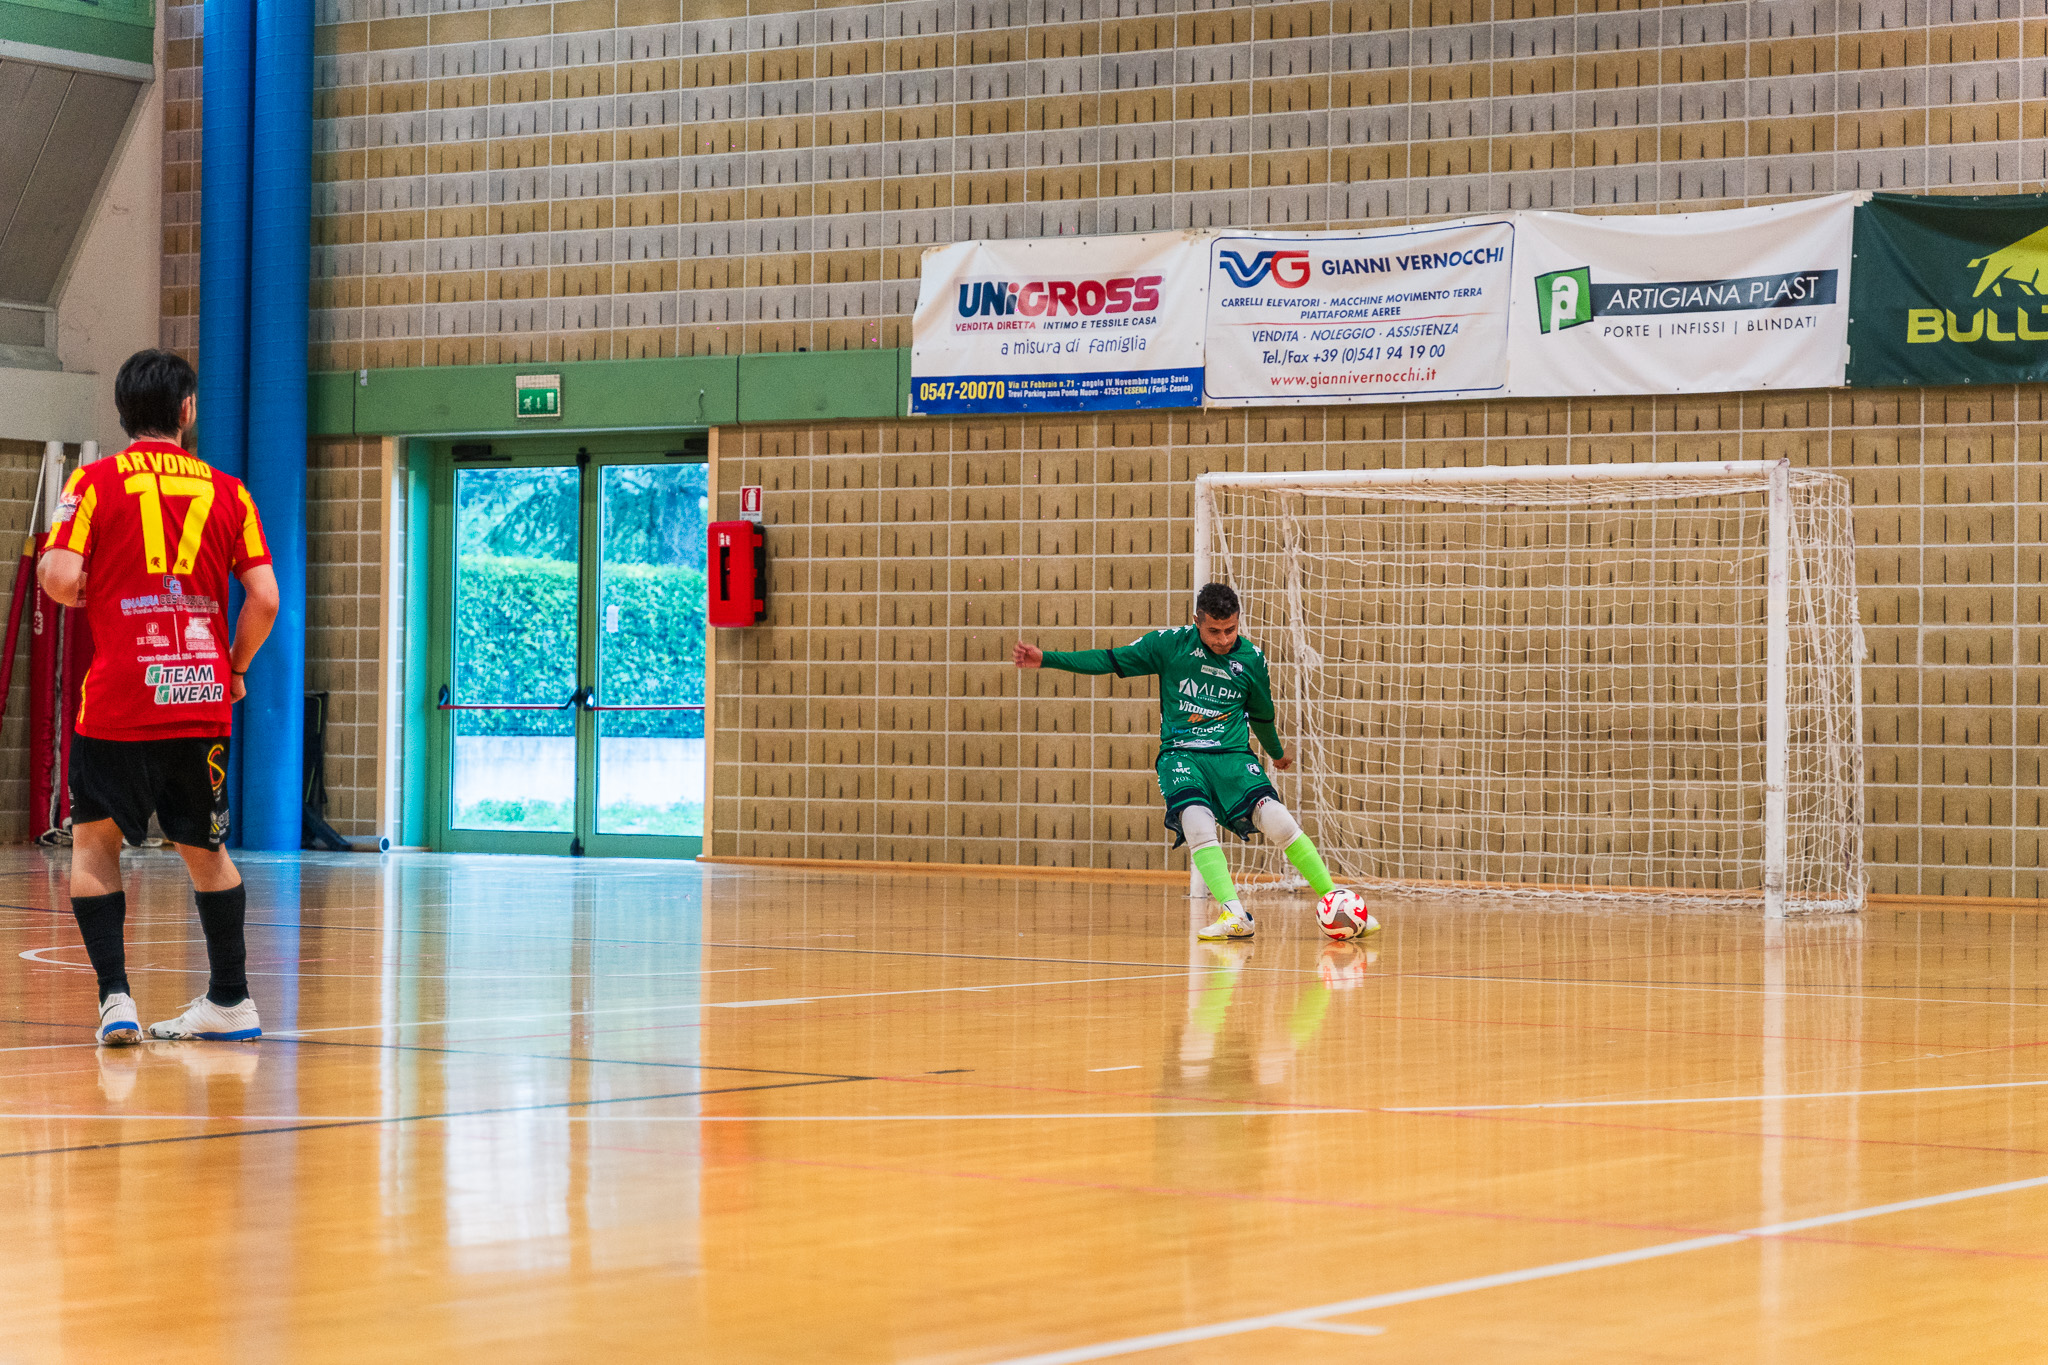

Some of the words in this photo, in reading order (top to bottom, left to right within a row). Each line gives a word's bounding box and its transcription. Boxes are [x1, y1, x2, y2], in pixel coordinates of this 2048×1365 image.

[1321, 254, 1391, 277] GIANNI
[1394, 246, 1505, 273] VERNOCCHI
[1221, 297, 1263, 308] CARRELLI
[1266, 297, 1320, 308] ELEVATORI
[1329, 294, 1383, 307] MACCHINE
[1386, 289, 1450, 303] MOVIMENTO
[1453, 286, 1483, 298] TERRA
[1606, 284, 1741, 310] ARTIGIANA
[1748, 276, 1820, 304] PLAST
[1300, 308, 1369, 320] PIATTAFORME
[1371, 305, 1401, 318] AEREE
[1906, 304, 2048, 343] BULL
[955, 321, 994, 332] VENDITA
[996, 320, 1036, 331] DIRETTA
[1043, 320, 1079, 330] INTIMO
[1081, 319, 1087, 329] E
[1090, 318, 1129, 328] TESSILE
[1131, 316, 1157, 326] CASA
[1252, 330, 1299, 343] VENDITA
[1310, 326, 1375, 342] NOLEGGIO
[1386, 322, 1459, 339] ASSISTENZA
[1603, 324, 1650, 338] PORTE
[1671, 320, 1726, 336] INFISSI
[1747, 316, 1818, 333] BLINDATI
[1000, 343, 1009, 356] a
[1013, 338, 1060, 355] misura
[1065, 338, 1081, 354] di
[1088, 335, 1147, 354] famiglia
[1262, 350, 1309, 366] Tel./Fax
[1313, 347, 1338, 364] +39
[1341, 346, 1381, 364] (0)541
[1386, 345, 1403, 360] 94
[1409, 345, 1424, 359] 19
[1429, 343, 1446, 358] 00
[1008, 381, 1020, 389] Via
[1029, 380, 1058, 389] Febbraio
[1082, 379, 1104, 388] angolo
[1115, 376, 1149, 386] Novembre
[1150, 375, 1169, 386] lungo
[1170, 374, 1189, 384] Savio
[1270, 366, 1437, 389] www.giannivernocchi.it
[920, 381, 1005, 401] 0547-20070
[1024, 389, 1046, 398] Parking
[1061, 388, 1078, 397] Ponte
[1103, 387, 1123, 396] 47521
[1124, 386, 1148, 395] CESENA
[114, 451, 213, 479] ARVONIO
[123, 472, 216, 575] 17
